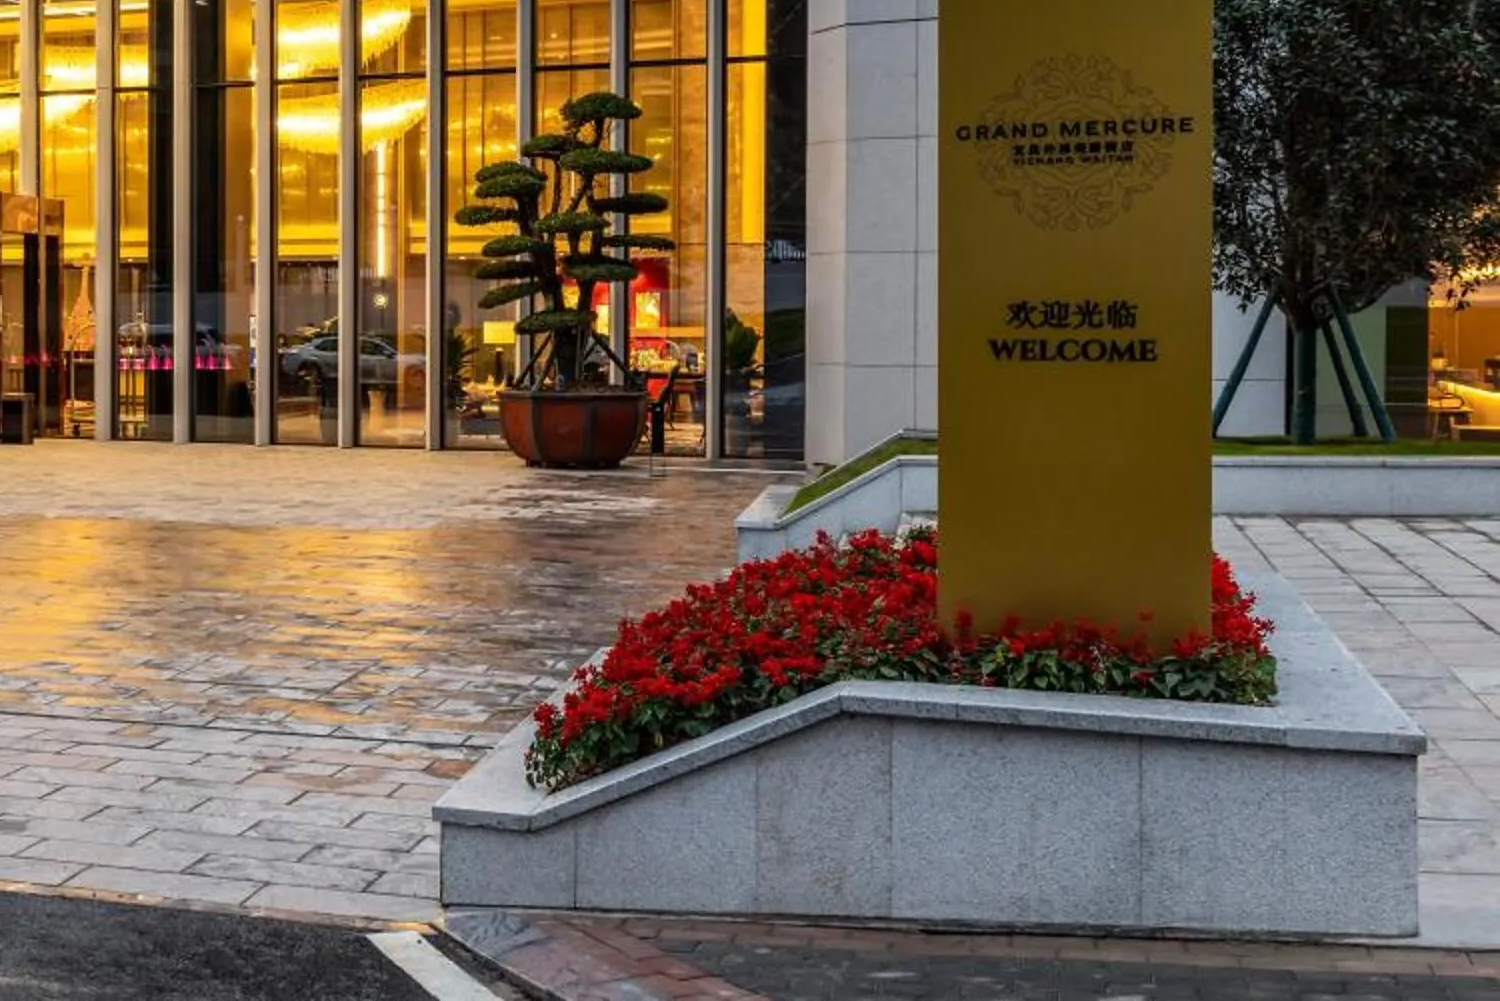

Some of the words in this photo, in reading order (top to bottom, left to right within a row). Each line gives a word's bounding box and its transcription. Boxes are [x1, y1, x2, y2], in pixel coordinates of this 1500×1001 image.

[955, 122, 1049, 141] GRAND
[1059, 116, 1194, 137] MERCURE
[1006, 300, 1138, 329] 欢迎光临
[988, 339, 1158, 362] WELCOME
